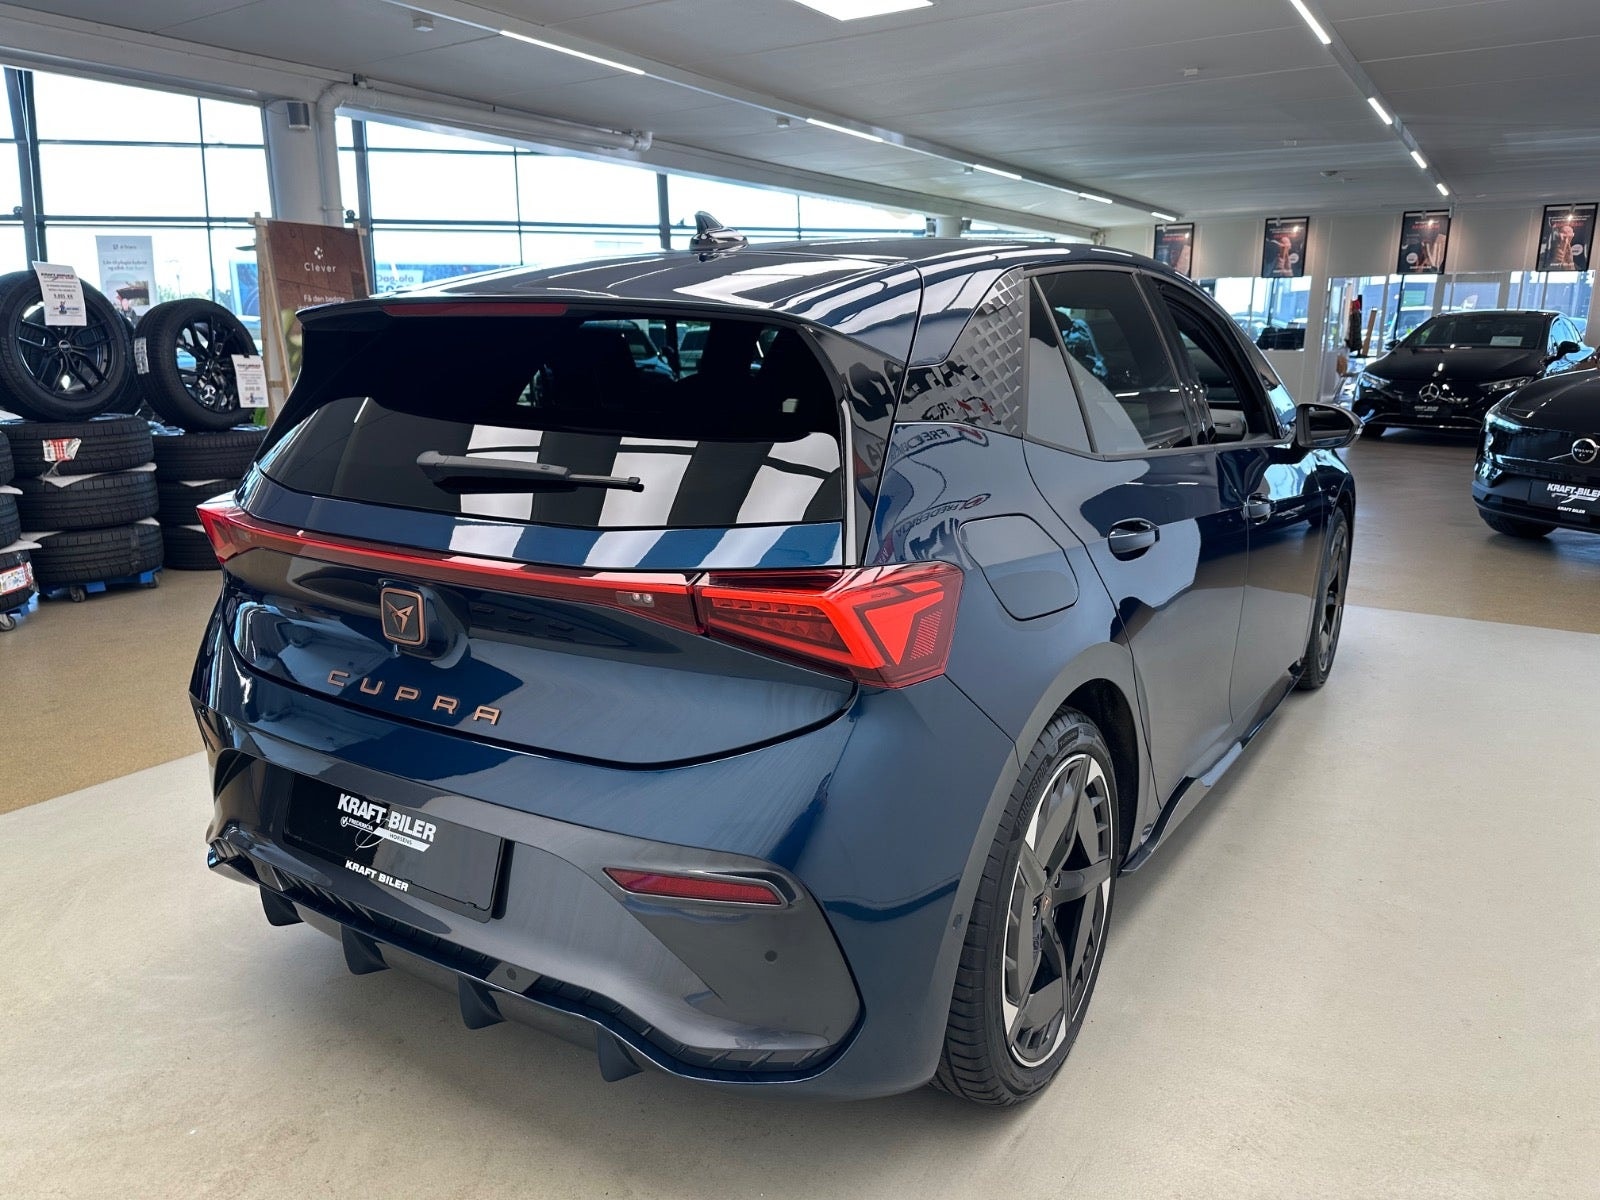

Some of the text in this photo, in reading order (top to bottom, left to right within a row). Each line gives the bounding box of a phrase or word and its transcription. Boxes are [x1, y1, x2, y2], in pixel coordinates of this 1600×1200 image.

[304, 262, 337, 273] Clever
[1547, 483, 1576, 495] KRAFT
[327, 670, 501, 726] CUPRA
[337, 793, 437, 843] KRAFT BILER
[345, 860, 409, 892] KRAFT BILER
